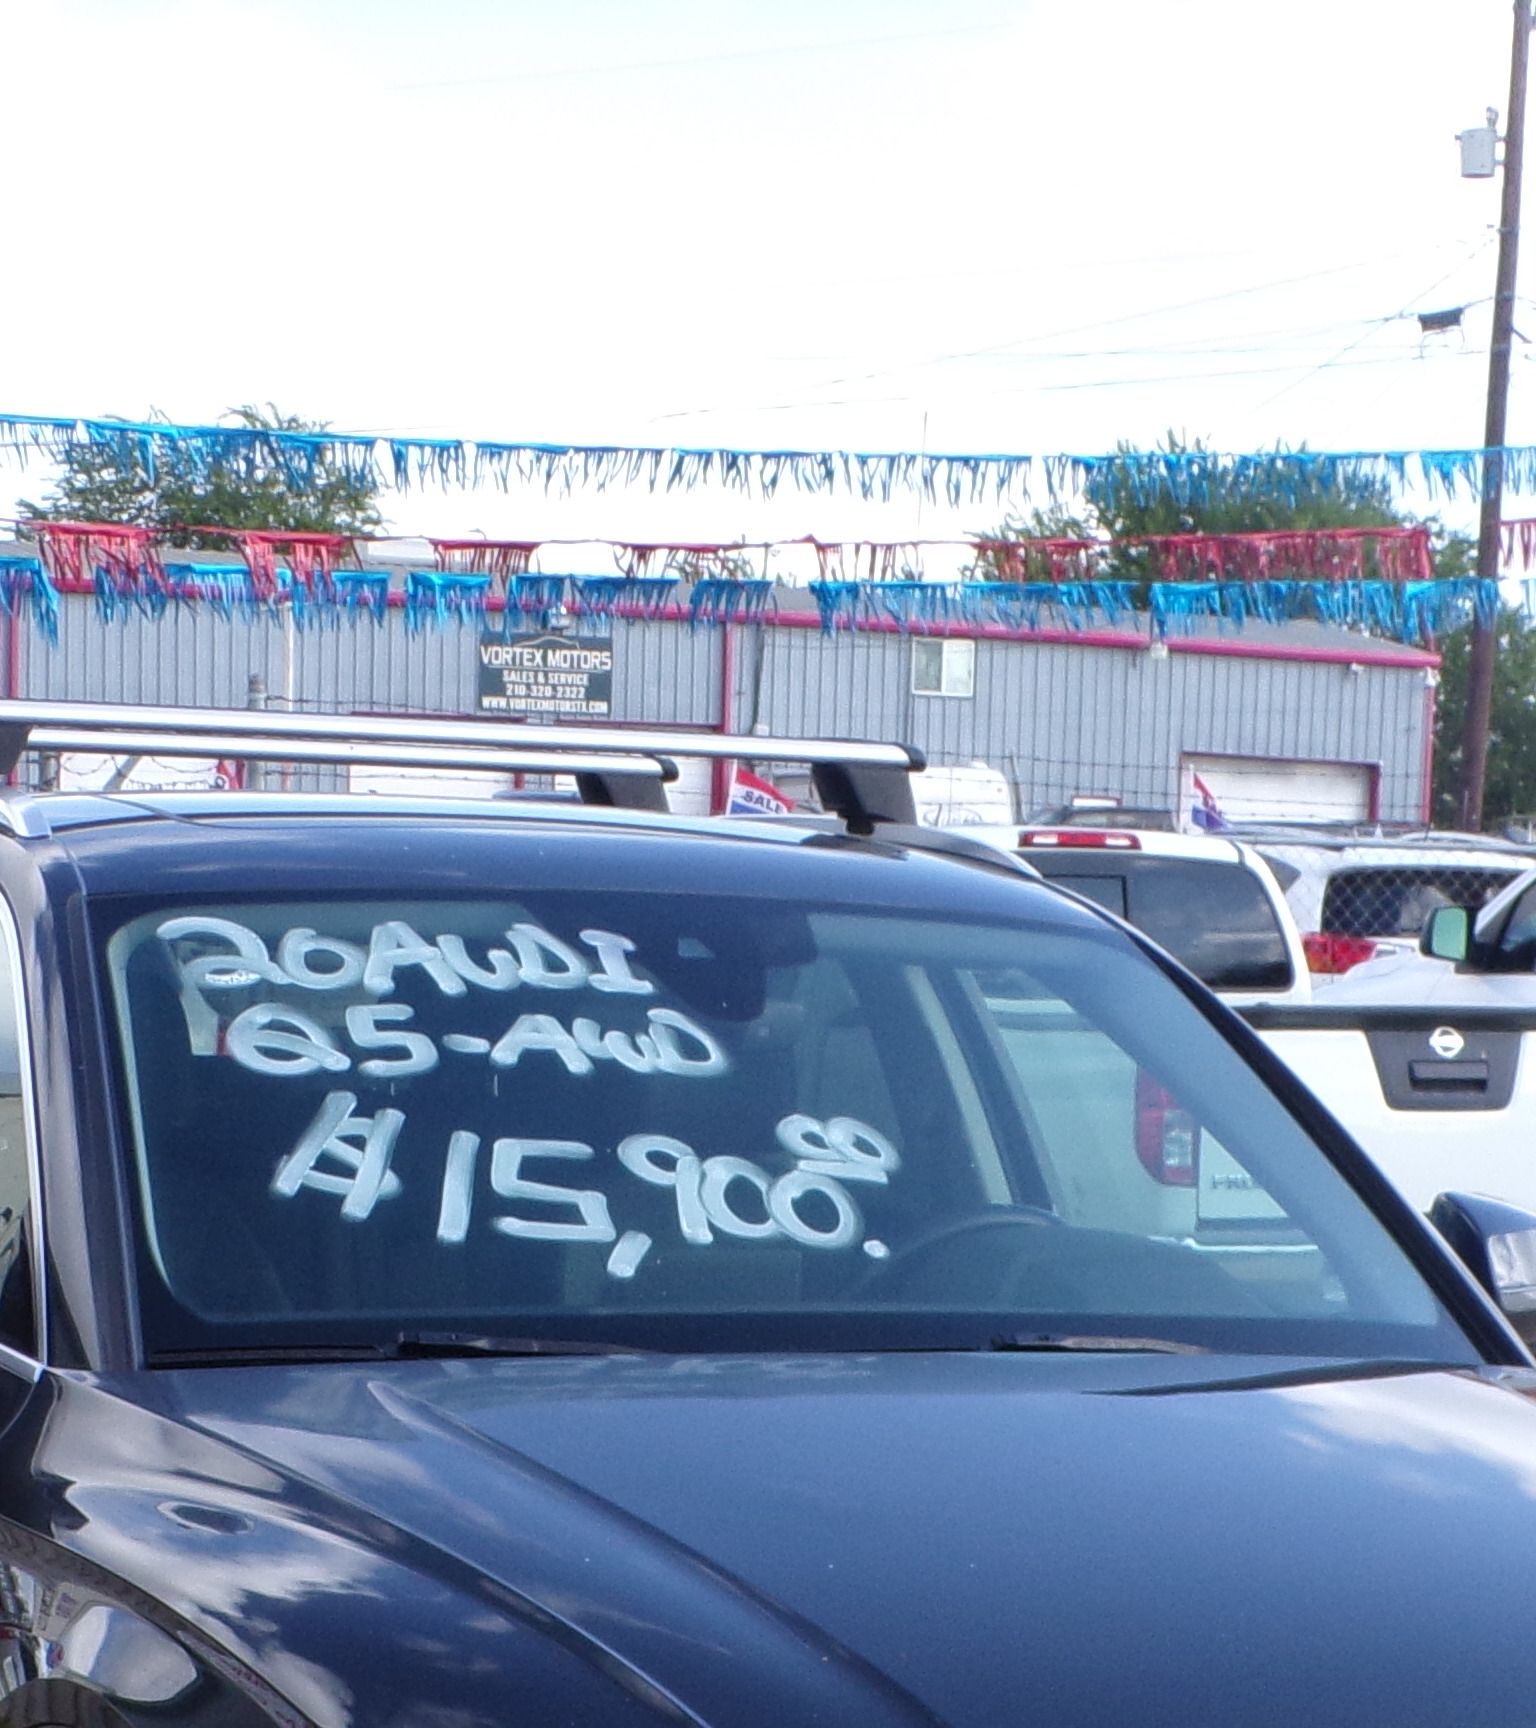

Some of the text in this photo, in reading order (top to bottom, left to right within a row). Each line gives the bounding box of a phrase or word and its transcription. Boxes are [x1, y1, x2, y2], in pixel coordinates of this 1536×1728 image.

[480, 646, 611, 671] VORTEX MOTORS
[503, 670, 589, 686] SALES & SERVICE
[506, 684, 585, 699] 210-320-2322
